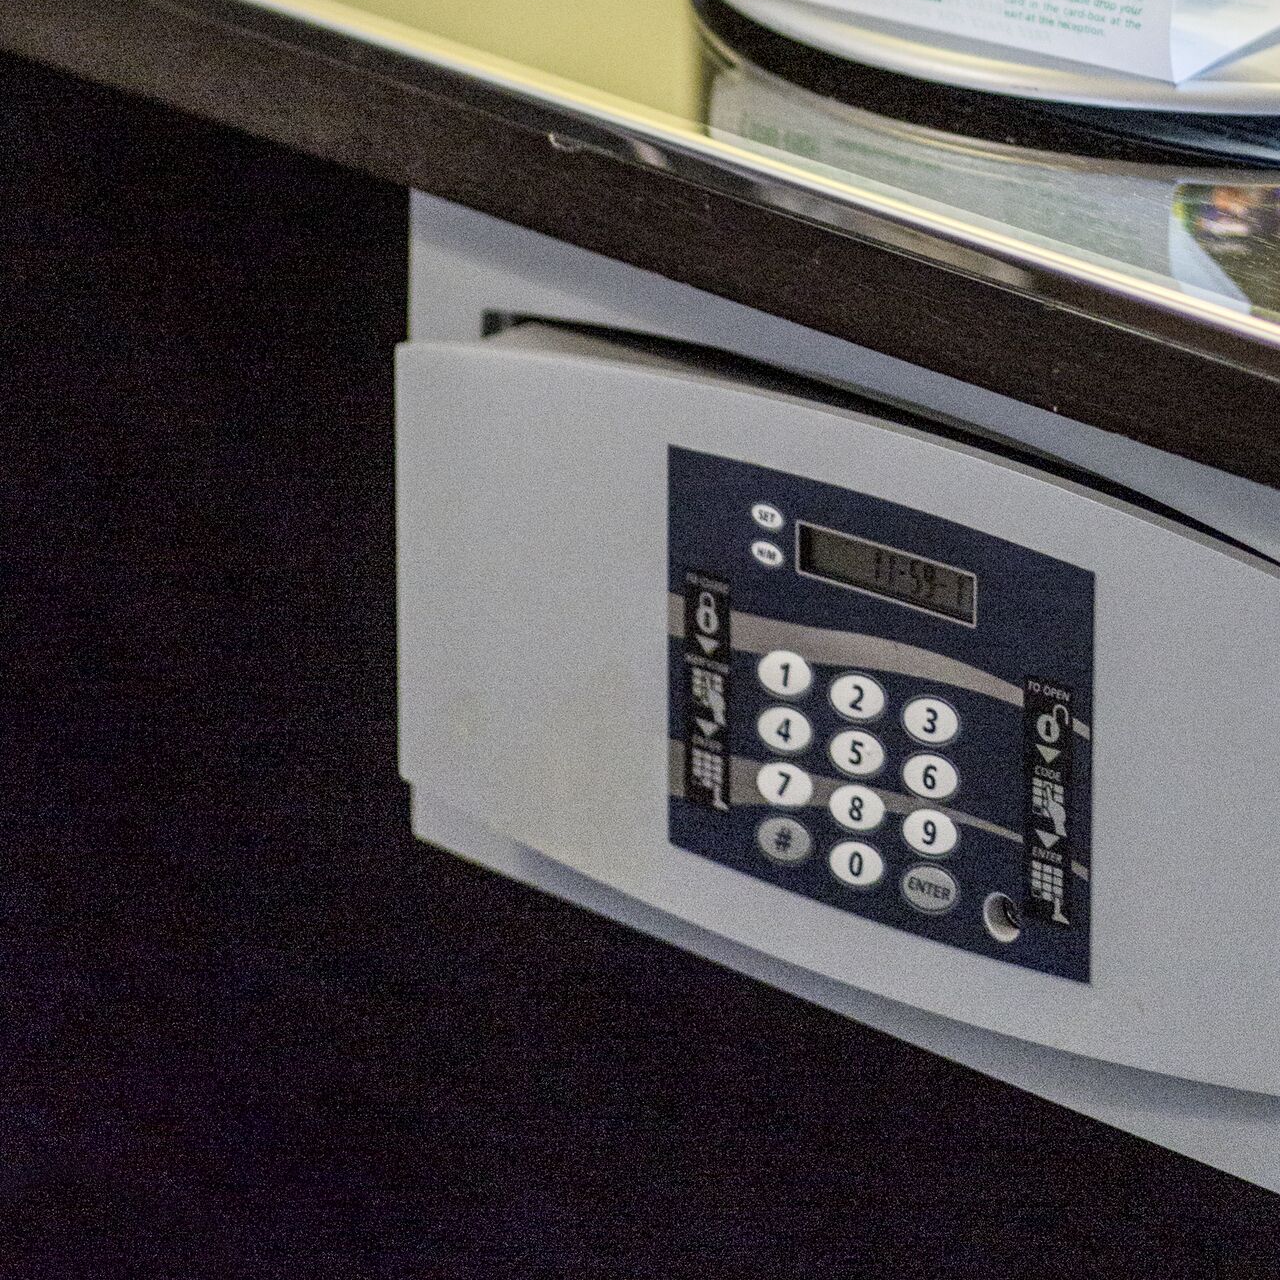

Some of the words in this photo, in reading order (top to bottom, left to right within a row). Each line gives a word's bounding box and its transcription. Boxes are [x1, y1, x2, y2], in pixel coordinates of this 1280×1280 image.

[1038, 15, 1055, 27] the
[1043, 3, 1059, 14] the
[1125, 19, 1142, 30] the
[1120, 5, 1143, 16] your
[757, 509, 776, 524] SET
[779, 662, 790, 687] 1
[850, 684, 864, 710] 2
[1028, 680, 1041, 692] TO
[1043, 685, 1071, 702] OPEN
[776, 718, 792, 743] 4
[922, 707, 939, 733] 3
[848, 741, 863, 766] 5
[777, 773, 792, 798] 7
[922, 764, 937, 790] 6
[1034, 765, 1061, 782] CODE
[848, 796, 864, 822] 8
[774, 827, 792, 851] #
[922, 820, 937, 846] 9
[848, 851, 863, 877] 0
[1032, 846, 1063, 864] ENTER
[907, 875, 951, 904] ENTER
